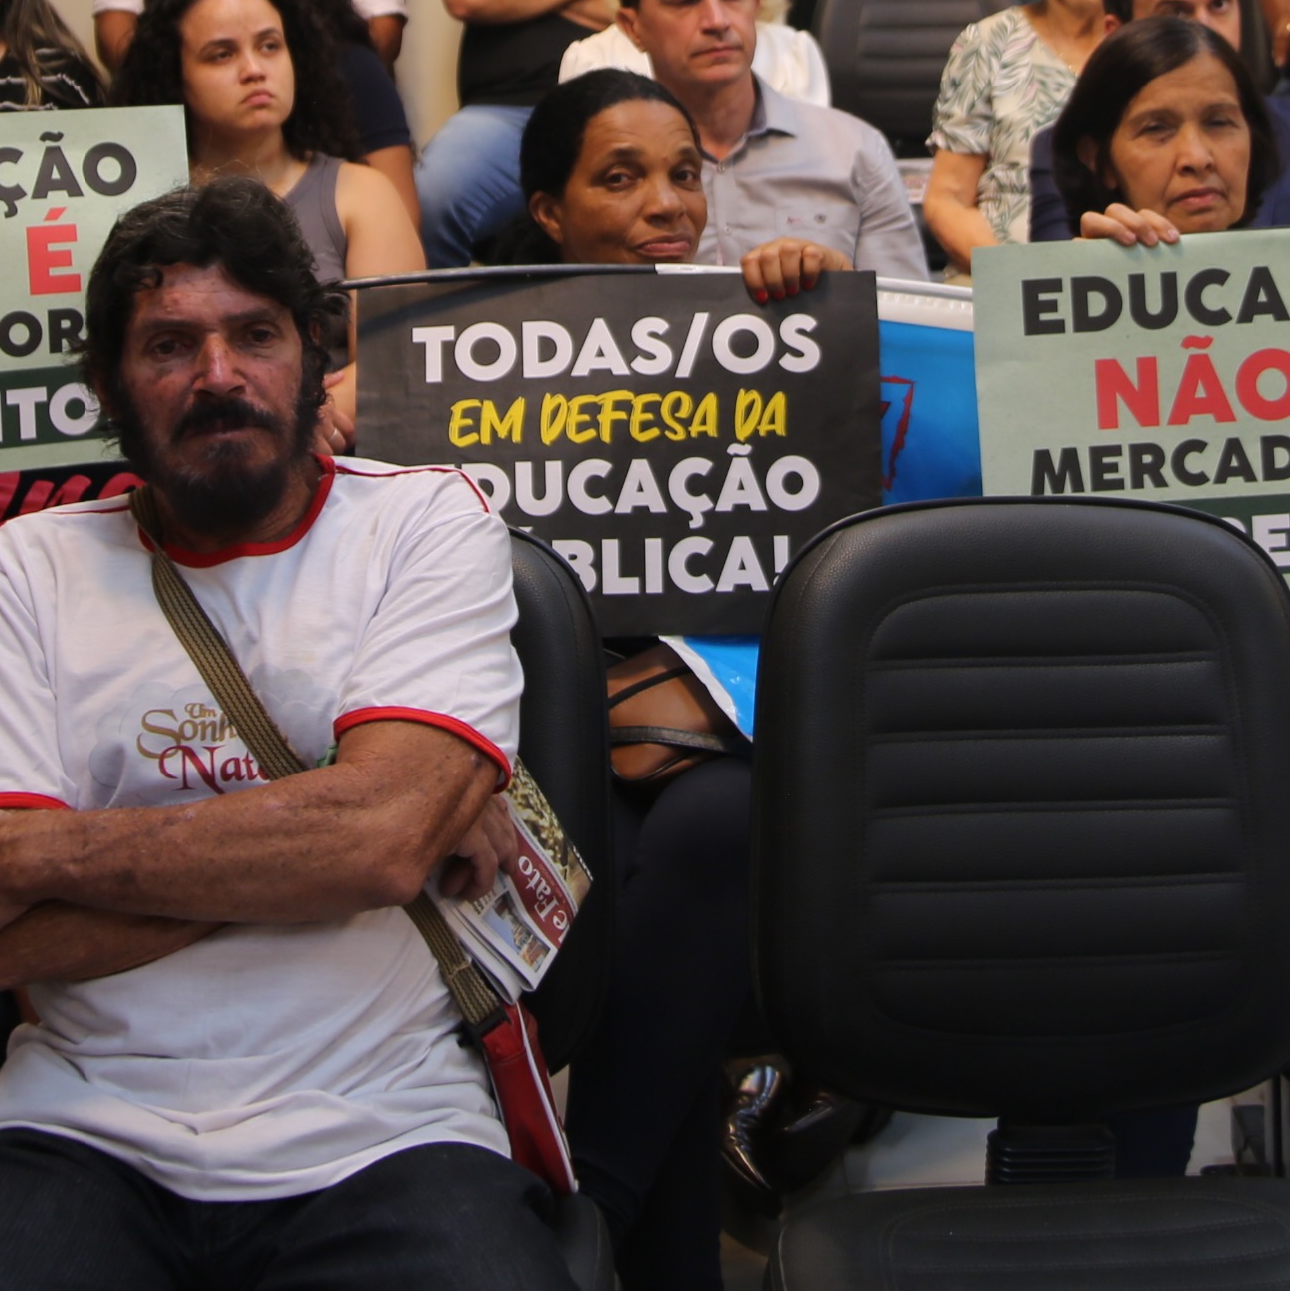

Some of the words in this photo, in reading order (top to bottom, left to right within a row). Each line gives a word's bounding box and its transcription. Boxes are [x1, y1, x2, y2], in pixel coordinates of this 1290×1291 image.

[25, 206, 82, 296] É
[412, 312, 821, 383] TODAS/OS
[448, 397, 525, 447] EM
[540, 389, 718, 446] DEFESA
[734, 388, 787, 442] DA
[411, 443, 821, 529] DUCAÇÃO
[518, 526, 789, 595] BLICA!
[136, 708, 238, 759] Sonh
[184, 702, 217, 719] Um
[158, 744, 270, 795] Nat
[518, 854, 559, 922] Fato
